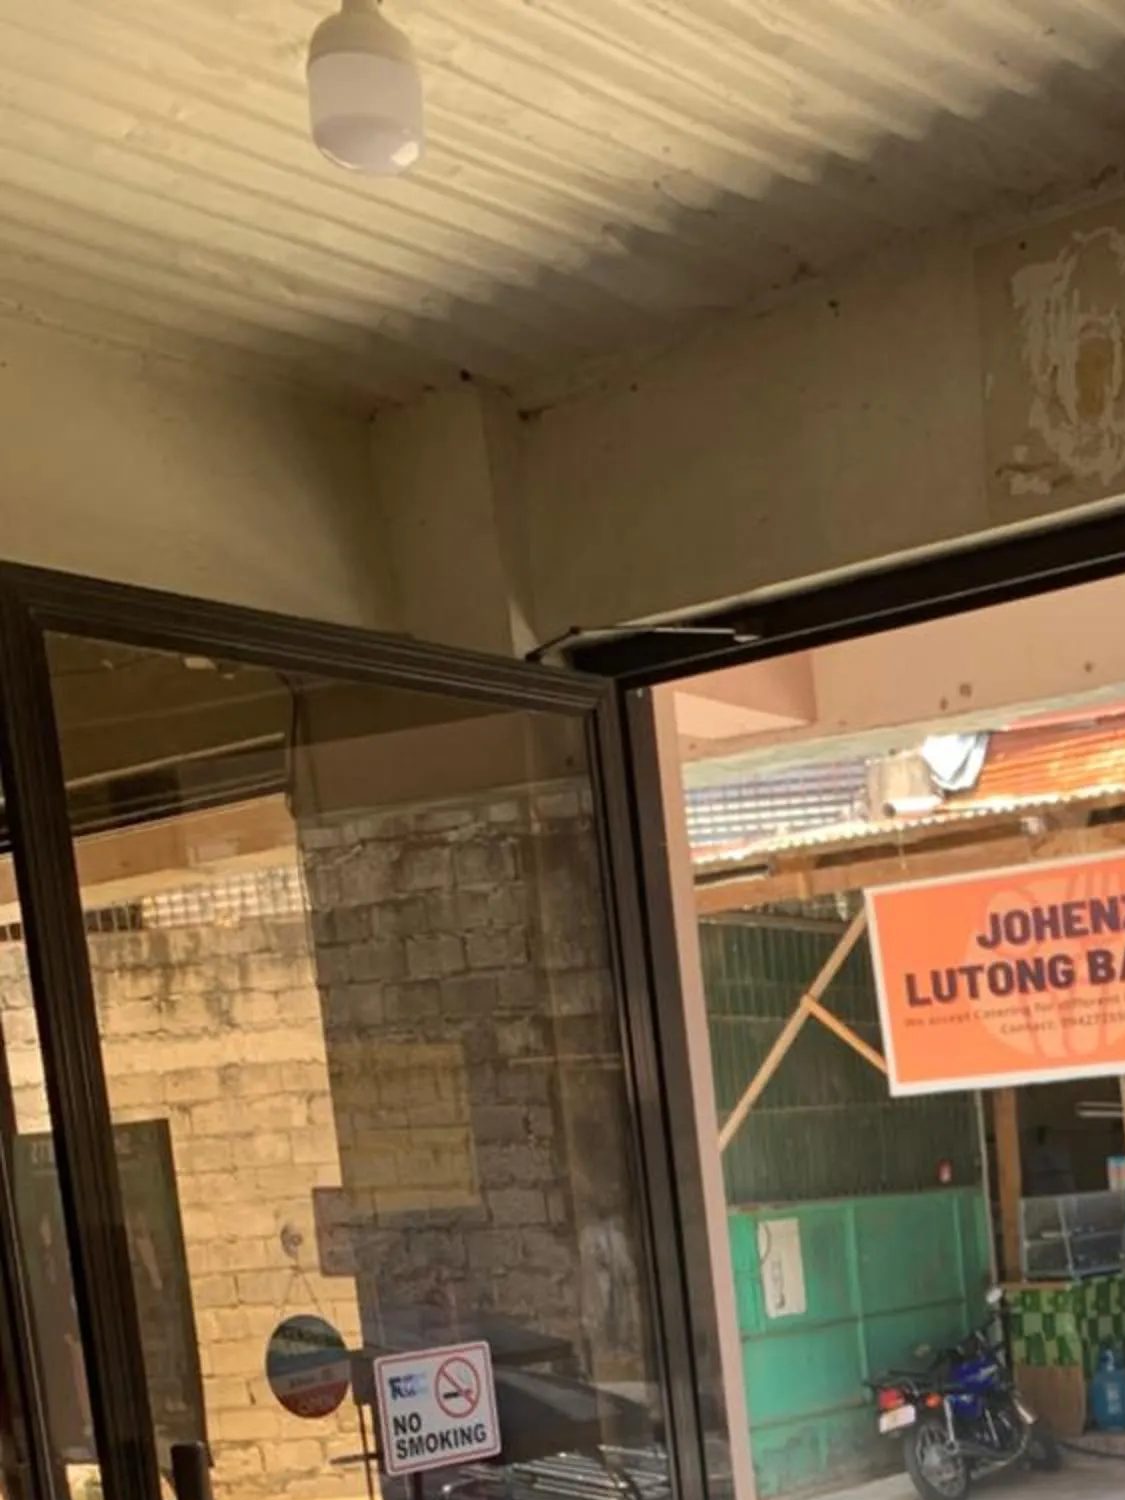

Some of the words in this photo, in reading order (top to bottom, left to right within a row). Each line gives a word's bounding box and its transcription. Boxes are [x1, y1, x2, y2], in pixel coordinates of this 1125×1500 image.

[905, 953, 1075, 1008] LUTONG
[393, 1411, 422, 1436] NO
[396, 1423, 487, 1460] SMOKING
